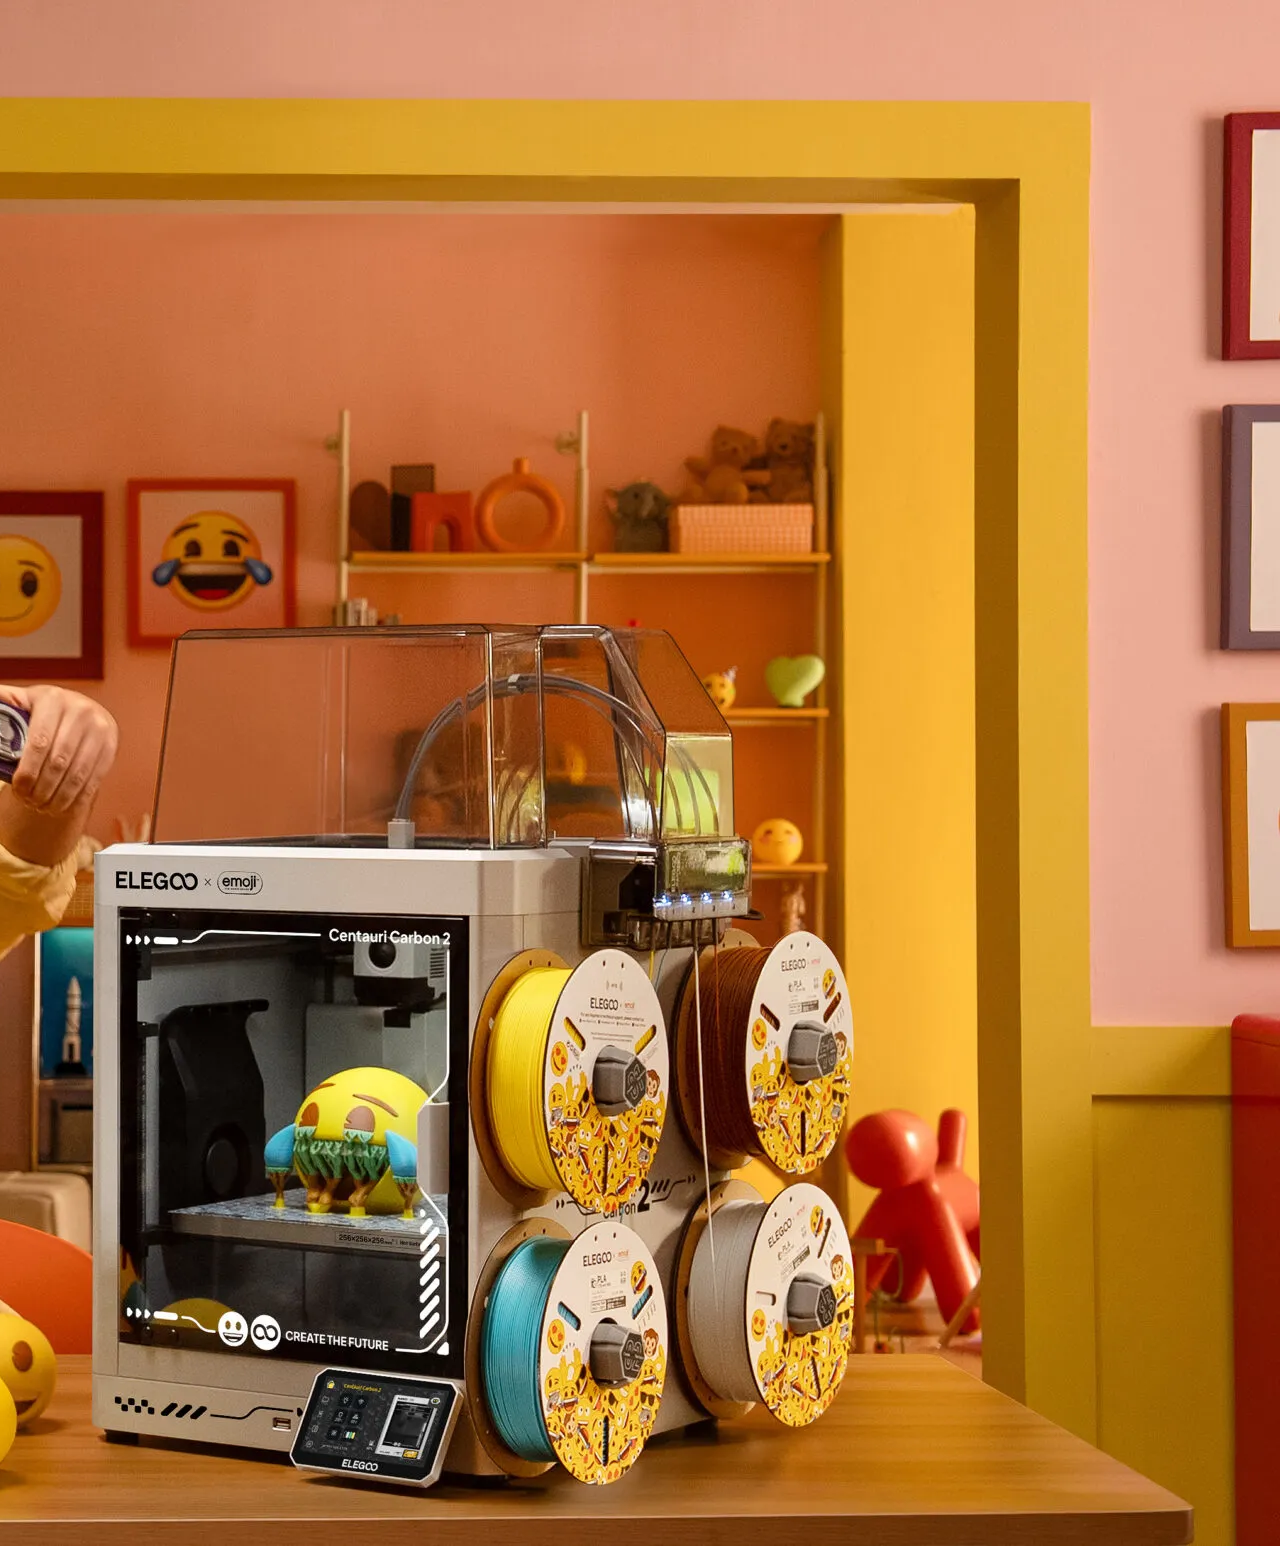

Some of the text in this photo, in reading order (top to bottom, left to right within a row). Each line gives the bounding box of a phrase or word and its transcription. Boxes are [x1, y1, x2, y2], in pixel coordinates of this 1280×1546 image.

[115, 871, 198, 891] ELEGOO
[329, 928, 451, 945] Centauri Carbon 2
[781, 958, 807, 972] ELEGOO
[590, 997, 619, 1011] ELEGOO
[638, 1179, 650, 1213] 2
[767, 1217, 793, 1249] ELEGOO
[582, 1251, 612, 1267] ELEGOO
[285, 1330, 389, 1351] CREATE THE FUTURE
[341, 1459, 379, 1472] ELEGOO
